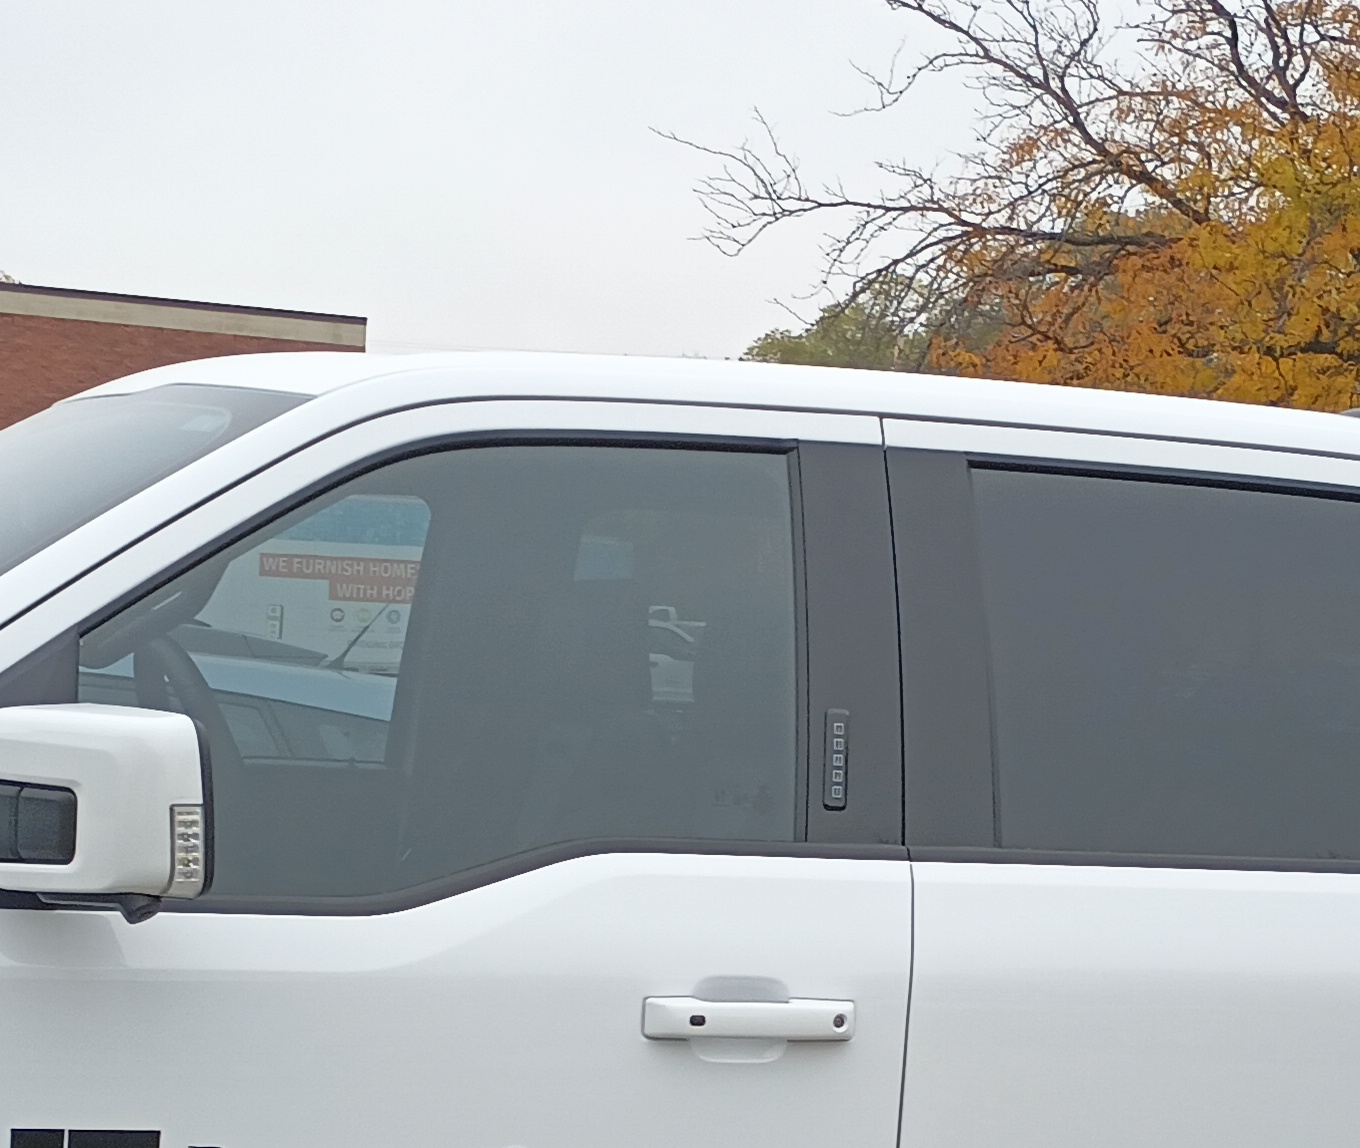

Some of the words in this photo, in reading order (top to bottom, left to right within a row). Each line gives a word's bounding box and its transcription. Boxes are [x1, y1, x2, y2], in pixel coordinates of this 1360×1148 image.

[263, 557, 289, 573] WE
[293, 558, 365, 577] FURNISH
[336, 583, 378, 599] WITH
